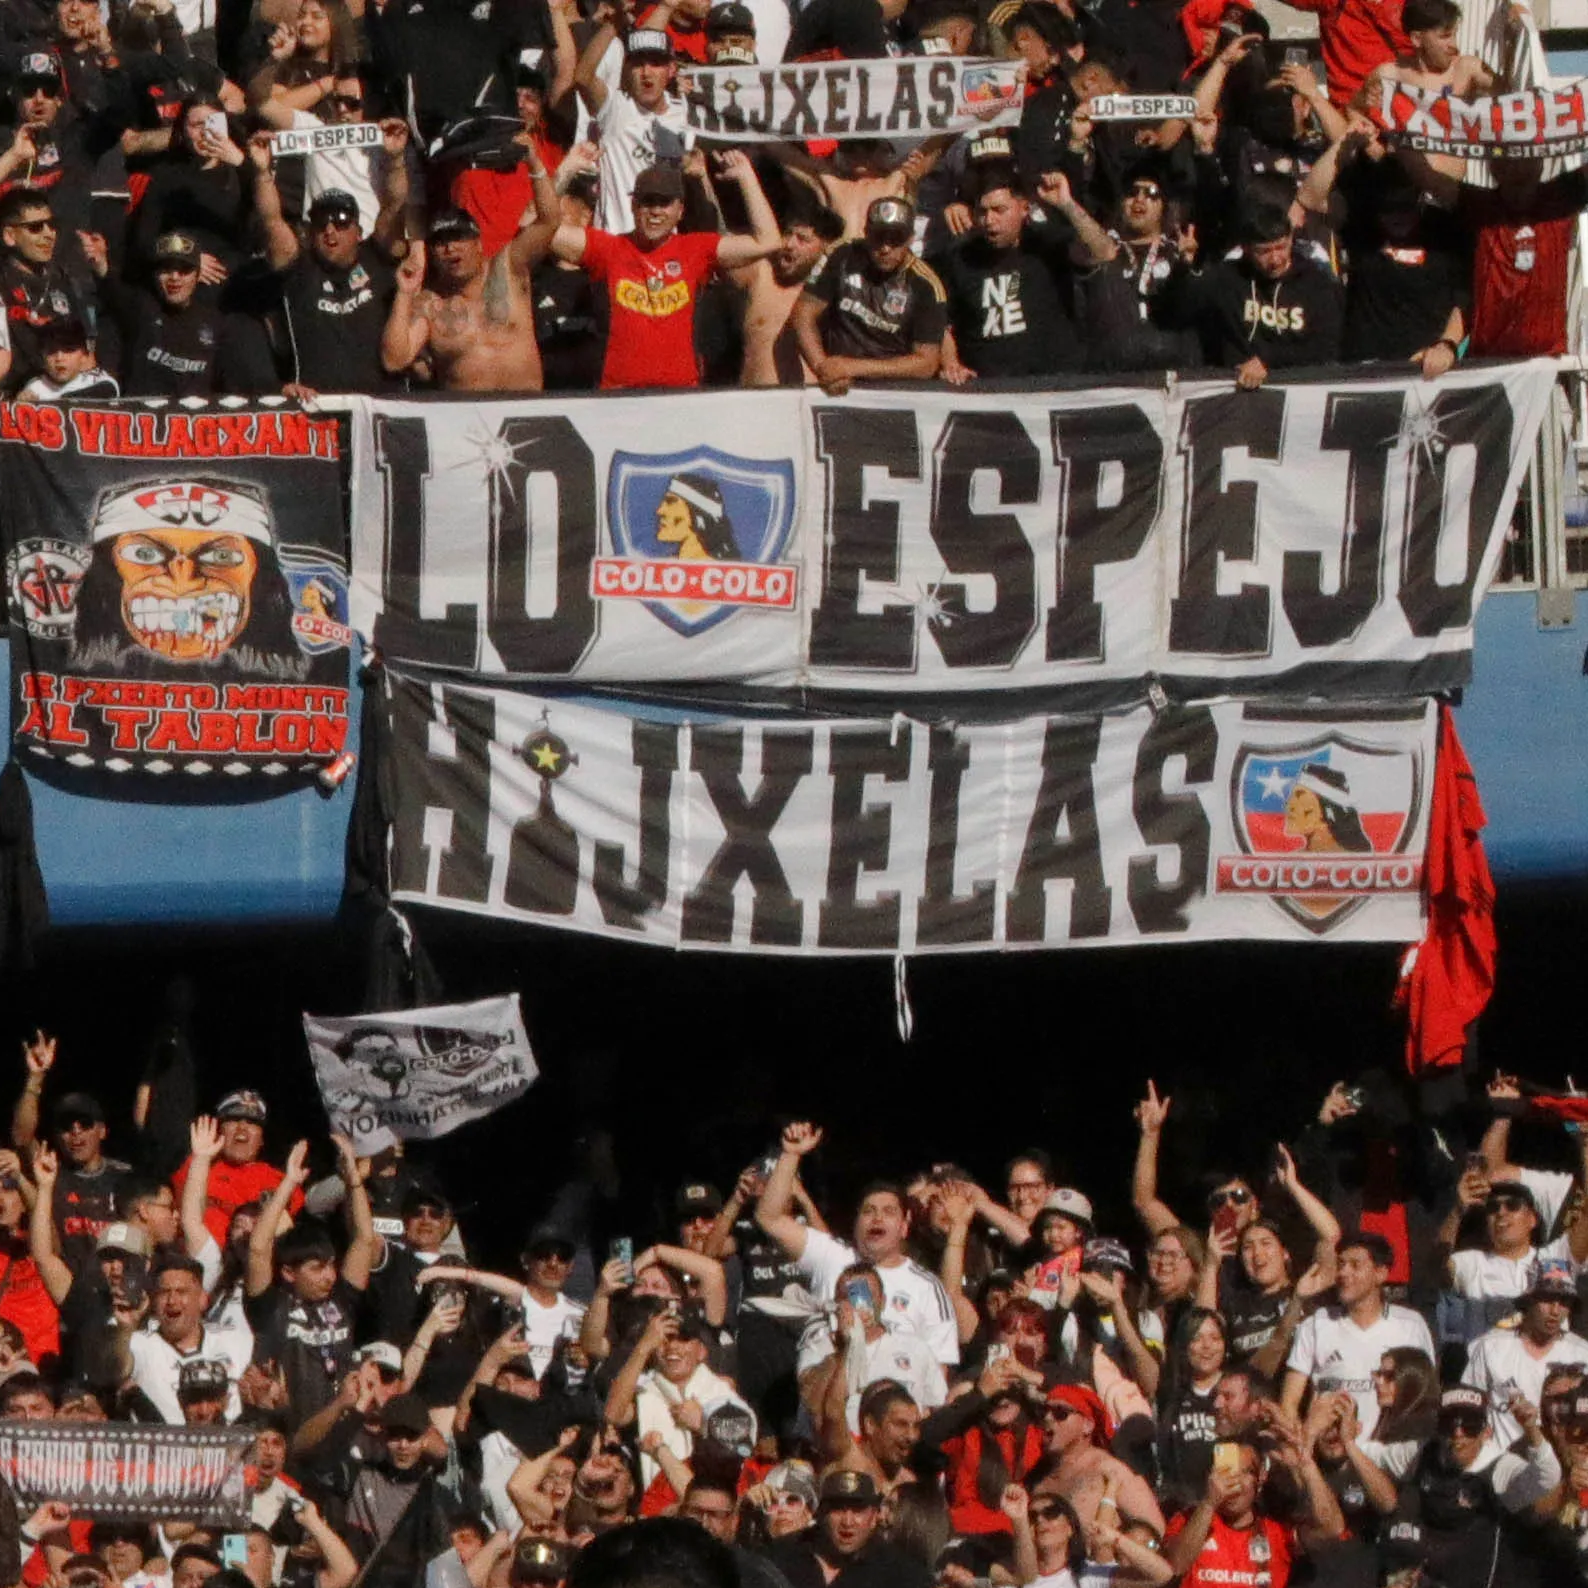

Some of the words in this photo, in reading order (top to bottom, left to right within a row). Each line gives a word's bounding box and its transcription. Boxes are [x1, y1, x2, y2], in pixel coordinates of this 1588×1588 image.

[688, 62, 956, 135] HJXELAS
[1093, 98, 1113, 116] LO
[1131, 97, 1196, 117] ESPEJO
[276, 133, 297, 152] LO
[313, 126, 379, 148] ESPEJO
[1245, 298, 1305, 331] BOSS
[0, 402, 67, 451] LOS
[371, 412, 600, 676] LO
[809, 384, 1517, 674] ESPEJO
[62, 678, 219, 711] PXERTO
[224, 684, 349, 714] MONTT
[17, 702, 90, 747] AL
[102, 706, 350, 757] TABLON
[388, 682, 1219, 952] HJXELAS
[1226, 857, 1422, 892] COLO-COLO
